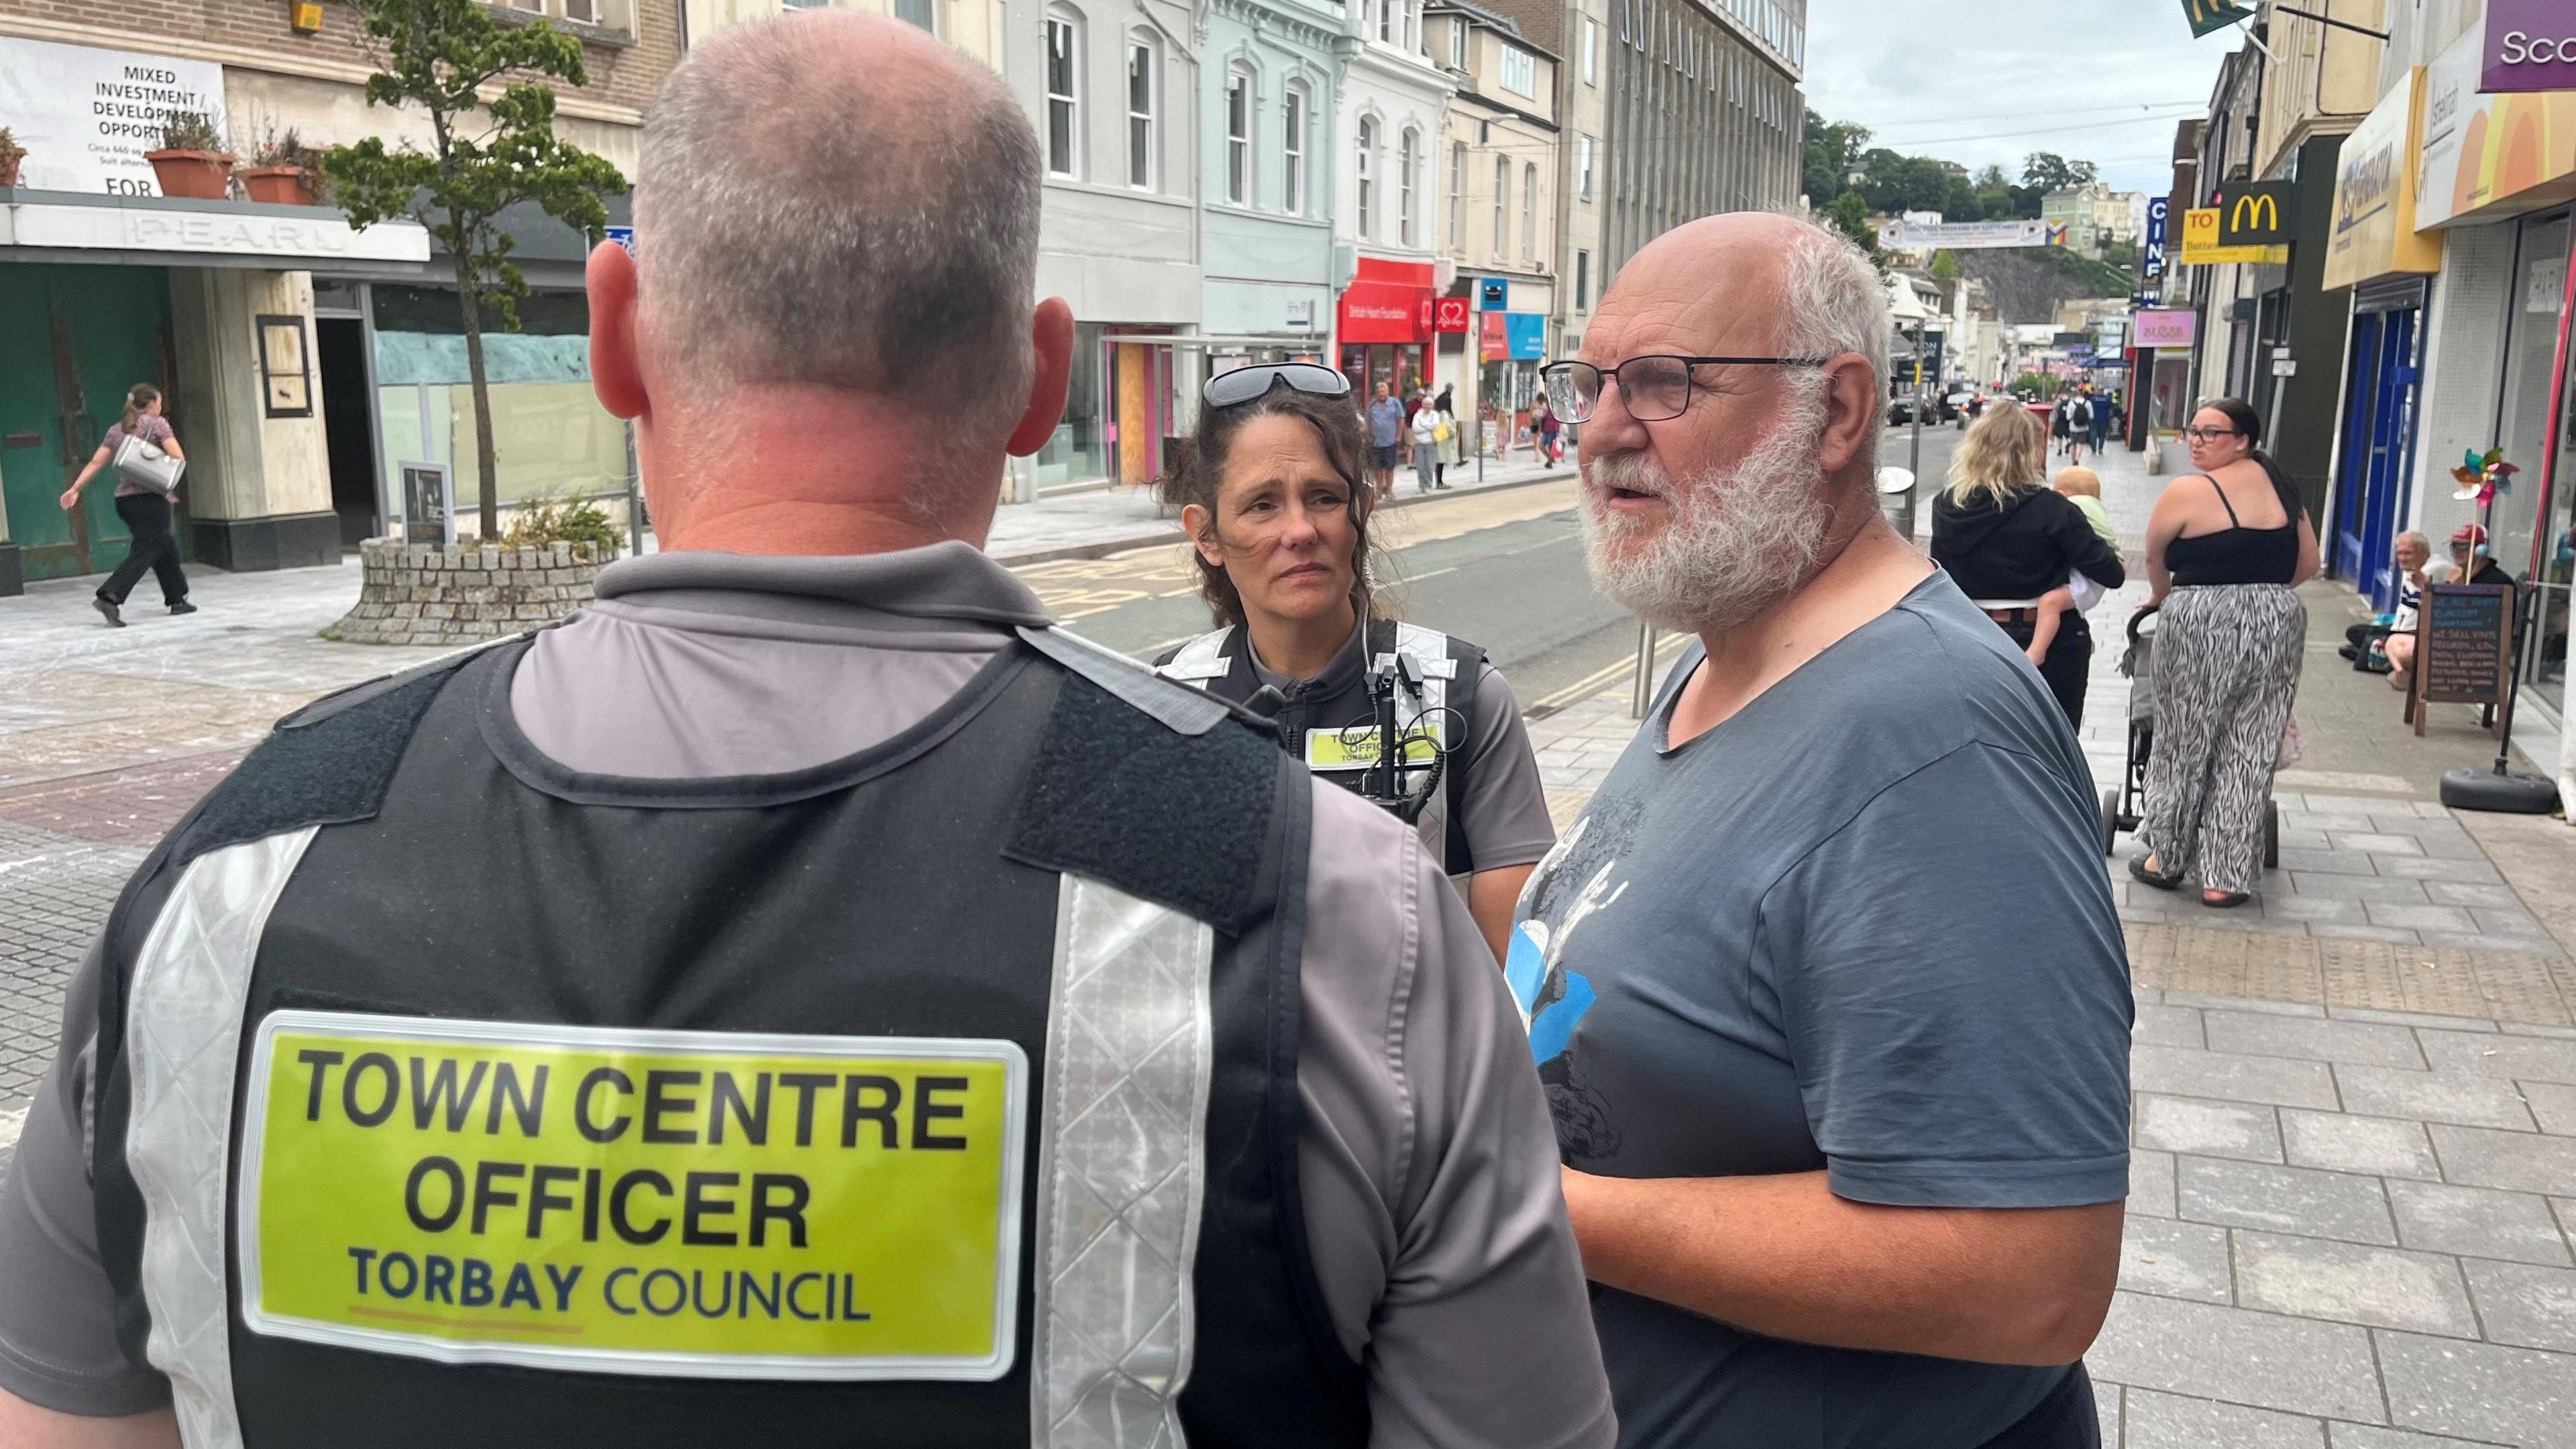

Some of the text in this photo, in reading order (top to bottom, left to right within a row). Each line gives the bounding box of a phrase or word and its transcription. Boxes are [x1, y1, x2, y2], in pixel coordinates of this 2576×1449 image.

[123, 66, 176, 84] MIXED
[95, 83, 195, 105] INVESTMENT
[105, 178, 152, 198] FOR
[2189, 213, 2213, 229] TO
[129, 217, 344, 252] PEARL
[1331, 733, 1367, 743] TOWN
[1342, 753, 1373, 761] TORBAY
[297, 1049, 969, 1151] TOWN CENTRE
[403, 1155, 812, 1249] OFFICER
[347, 1246, 871, 1322] TORBAY COUNCIL
